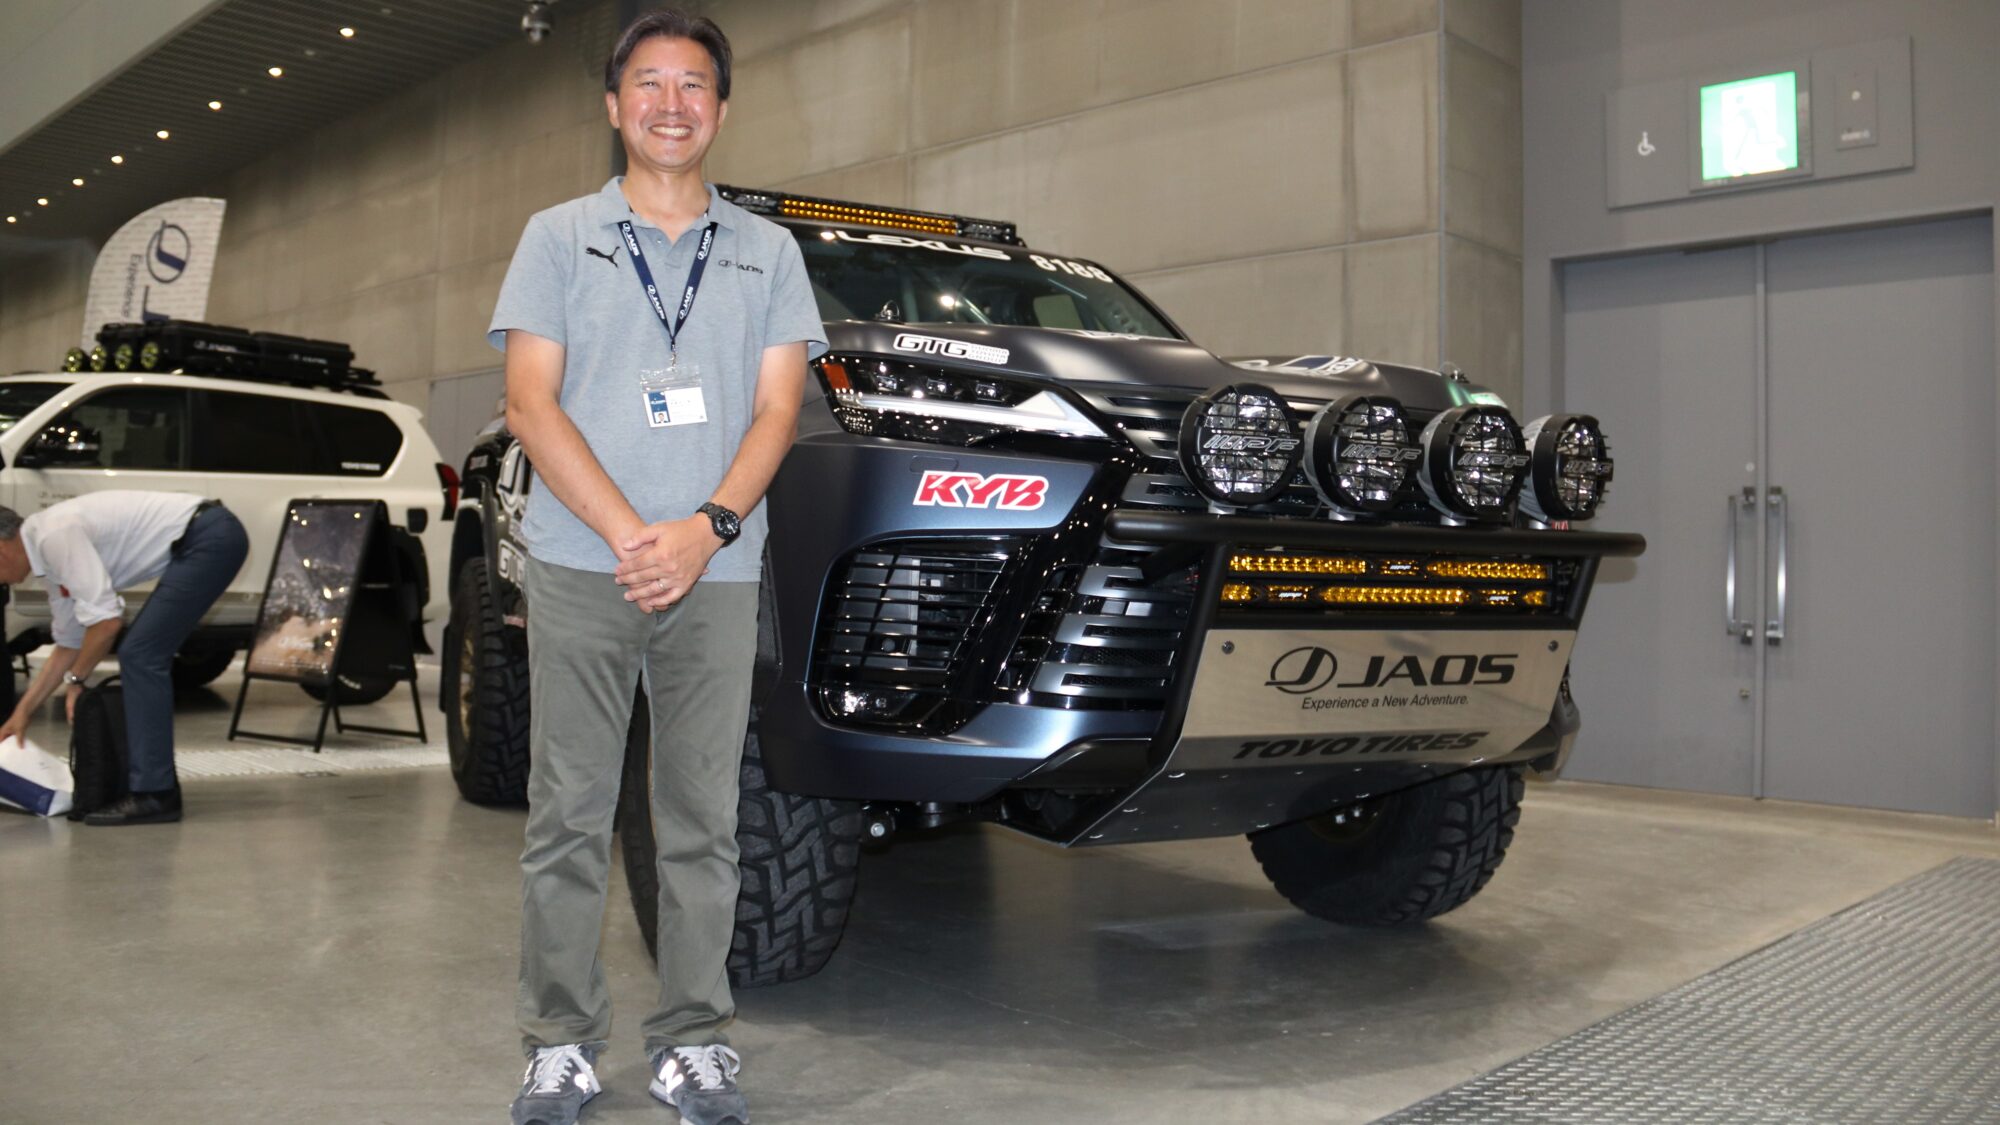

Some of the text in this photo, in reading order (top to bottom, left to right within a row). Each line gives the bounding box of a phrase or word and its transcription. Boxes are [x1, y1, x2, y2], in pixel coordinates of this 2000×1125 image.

[835, 230, 1012, 261] LEXUS
[1029, 254, 1114, 284] 8188
[895, 335, 969, 357] GTG
[913, 470, 1049, 511] KYB
[1337, 653, 1519, 688] JAOS
[1301, 696, 1370, 712] Experience
[1371, 699, 1379, 708] a
[1381, 695, 1407, 708] New
